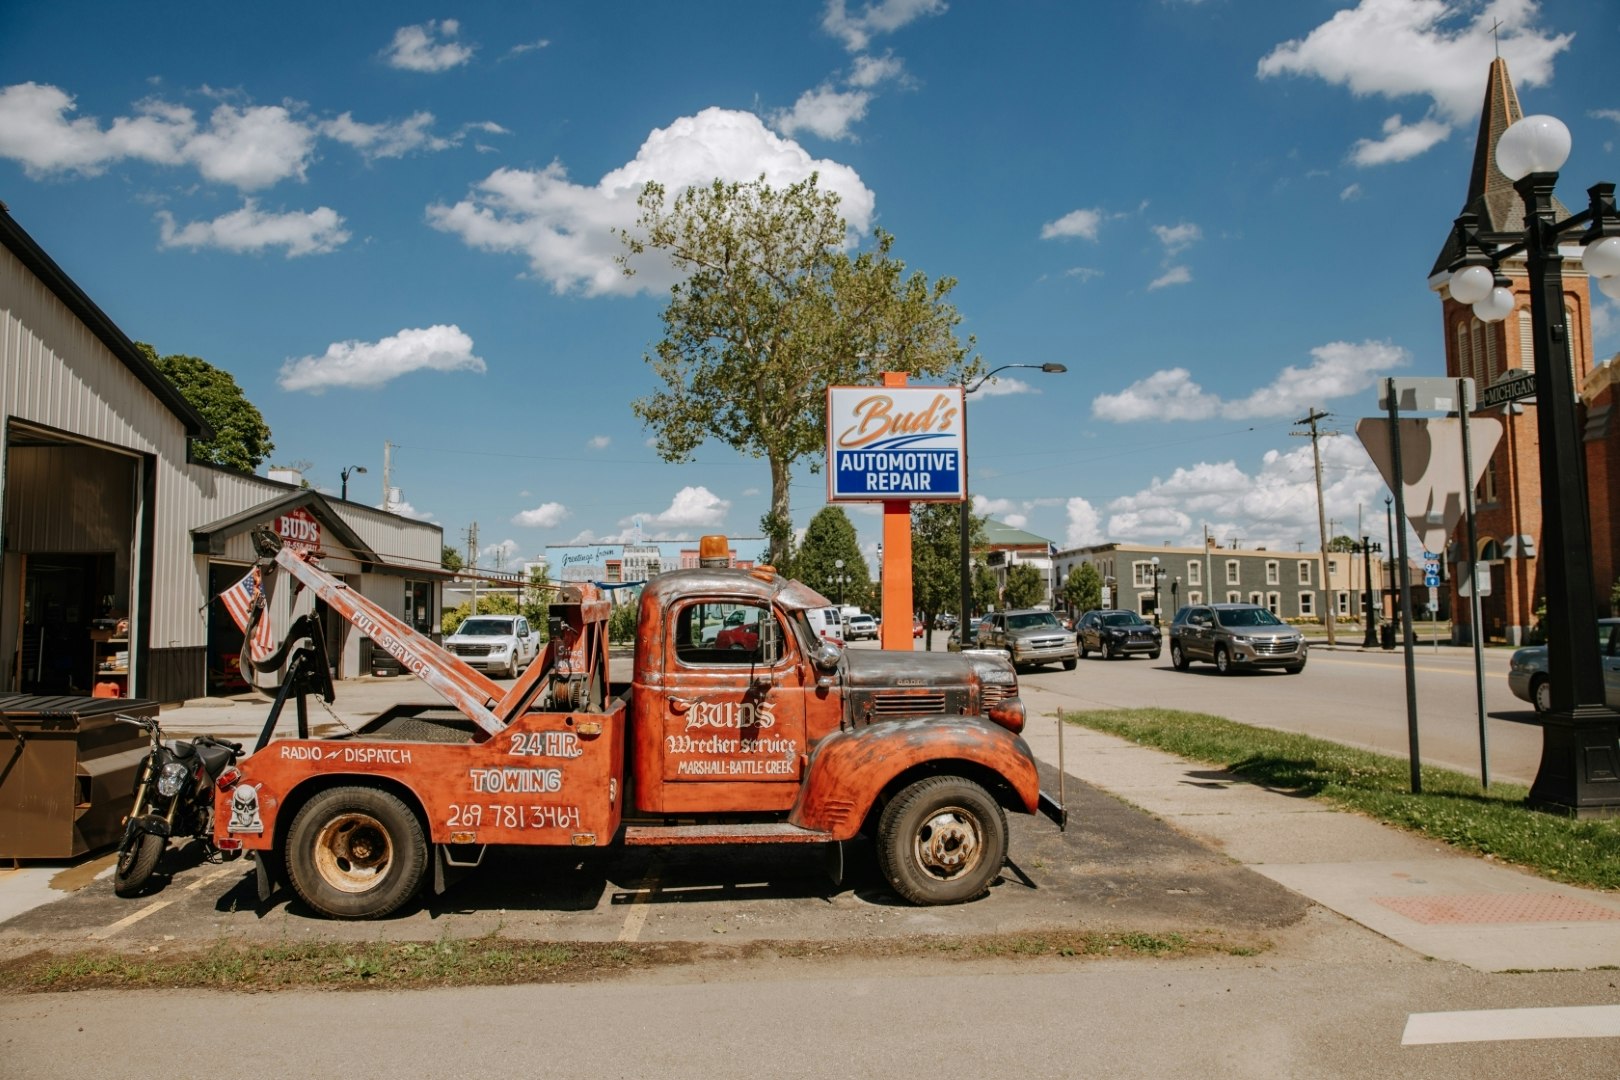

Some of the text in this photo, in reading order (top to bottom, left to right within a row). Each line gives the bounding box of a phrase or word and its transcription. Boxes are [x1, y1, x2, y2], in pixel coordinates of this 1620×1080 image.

[1489, 377, 1535, 404] MICHIGAN
[837, 393, 957, 449] Bud's
[840, 453, 956, 471] AUTOMOTIVE
[866, 472, 931, 491] REPAIR
[280, 515, 317, 542] BUD'S
[562, 547, 614, 567] Greetings from
[1425, 563, 1437, 573] 94
[351, 610, 430, 679] FULL SERVICE
[558, 645, 583, 656] Since
[680, 699, 776, 732] BUD'S
[281, 746, 411, 763] RADIO DISPATCH
[508, 732, 583, 757] 24 HR.
[666, 733, 796, 754] Wrecker service
[678, 760, 794, 774] MARSHALL-BATTLE CREEK
[470, 769, 561, 792] TOWING
[446, 804, 580, 828] 269 781 3464
